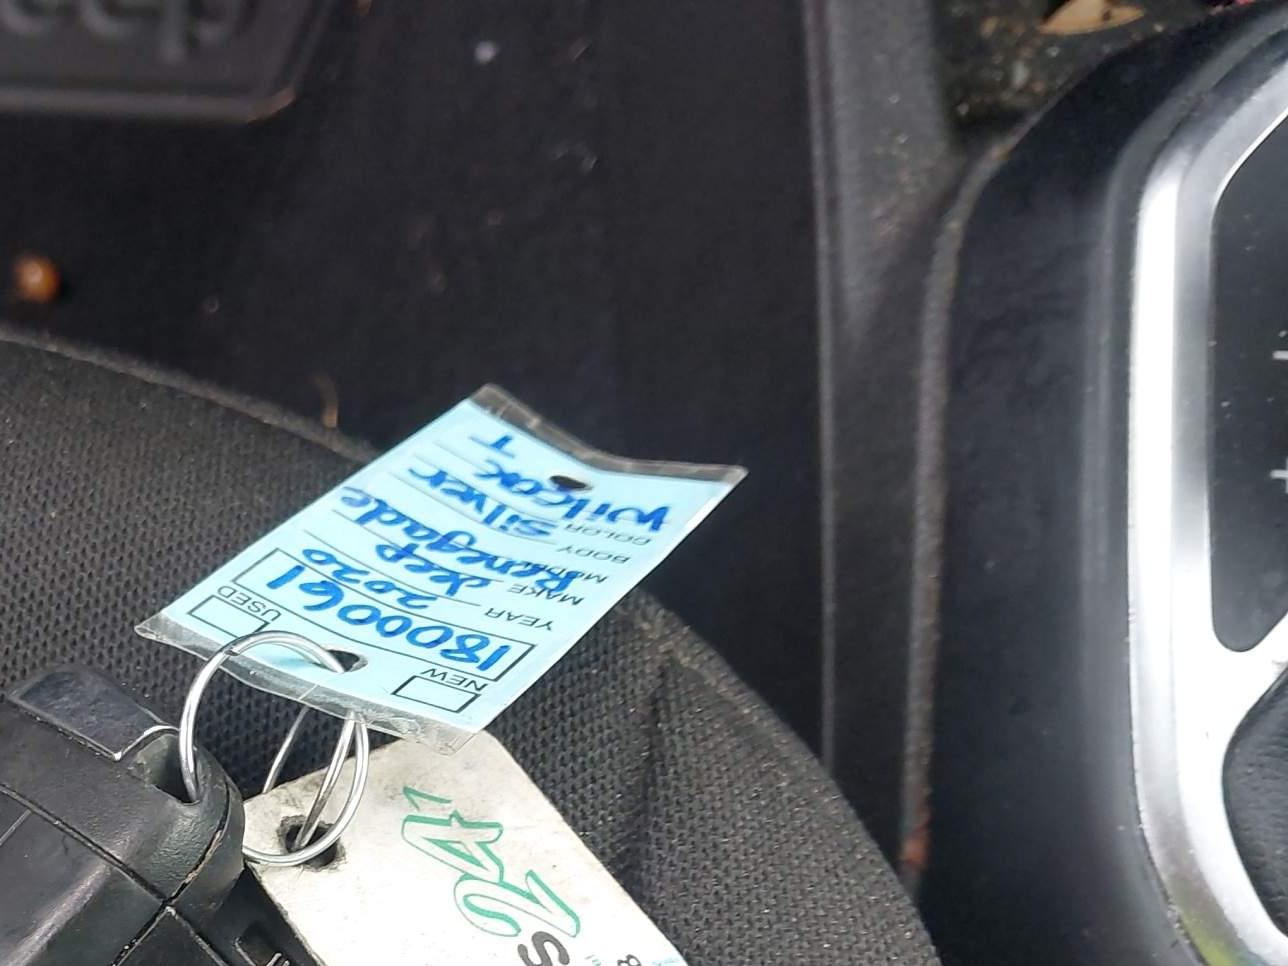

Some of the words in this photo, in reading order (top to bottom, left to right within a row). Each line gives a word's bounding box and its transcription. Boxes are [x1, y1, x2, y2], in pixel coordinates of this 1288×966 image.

[563, 521, 652, 547] COLOR
[558, 544, 632, 565] BODY
[301, 548, 439, 609] 2020
[216, 584, 282, 622] USED
[510, 582, 585, 607] MAKE
[266, 564, 511, 671] 1800061
[483, 606, 555, 632] YEAR
[420, 667, 489, 692] NEW
